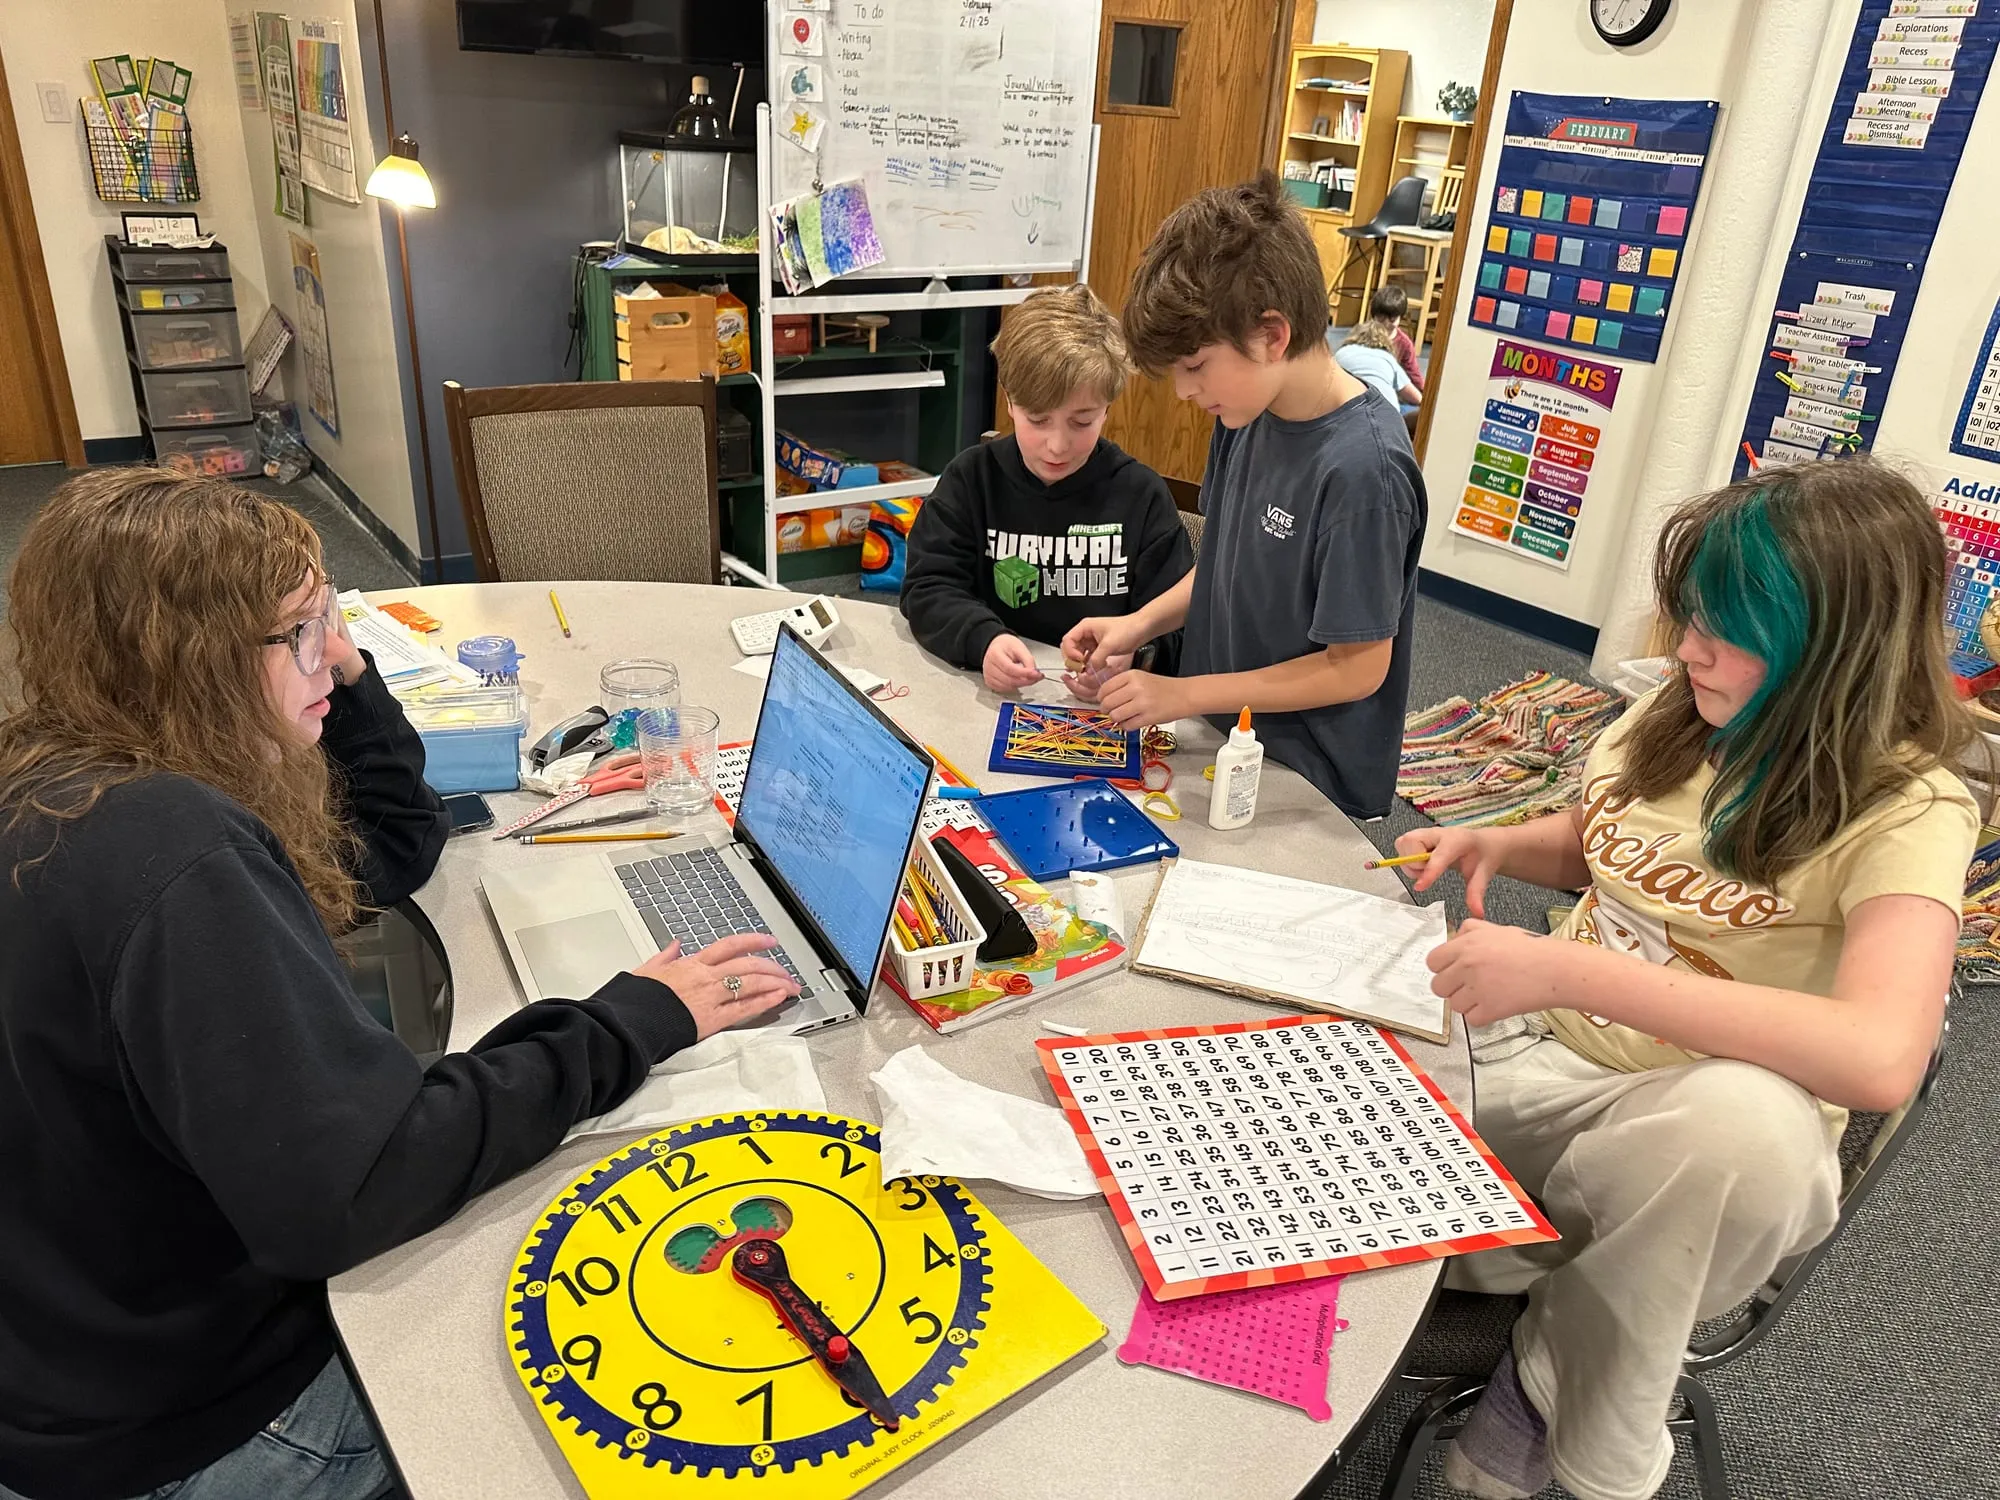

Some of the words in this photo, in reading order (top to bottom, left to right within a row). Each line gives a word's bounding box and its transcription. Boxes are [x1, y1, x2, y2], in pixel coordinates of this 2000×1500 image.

[854, 4, 866, 19] To
[872, 4, 884, 19] do
[1895, 23, 1948, 34] Explorations
[841, 32, 871, 51] Writing
[1899, 47, 1928, 56] Recess
[1885, 75, 1906, 85] Bible
[1908, 76, 1937, 86] Lesson
[1877, 98, 1916, 108] Afternoon
[1879, 107, 1910, 118] Meeting
[1570, 124, 1627, 141] FEBRUARY
[1867, 121, 1892, 131] Recess
[1894, 123, 1909, 131] and
[1868, 130, 1903, 140] Dismissal
[1844, 291, 1866, 301] Trash
[1805, 313, 1828, 326] Lizard
[1784, 326, 1813, 339] Teacher
[1807, 355, 1826, 366] Wipe
[1501, 347, 1606, 392] MONTHS
[1988, 368, 1997, 378] 71
[1803, 380, 1825, 392] Snack
[1982, 385, 1991, 395] 81
[1520, 390, 1538, 400] There
[1553, 398, 1561, 406] 12
[1563, 402, 1589, 413] months
[1798, 401, 1822, 413] Prayer
[1977, 402, 1986, 411] 91
[1497, 406, 1527, 421] January
[1970, 417, 1982, 427] 101
[1490, 427, 1522, 443] February
[1561, 423, 1578, 435] July
[1790, 422, 1805, 434] Flag
[1805, 425, 1828, 437] Salute
[1795, 432, 1819, 444] Leader
[1967, 433, 1976, 443] 111
[1983, 436, 1994, 446] 112
[1490, 450, 1513, 463] March
[1550, 445, 1578, 460] August
[1488, 473, 1505, 484] April
[1538, 465, 1579, 484] September
[1483, 495, 1499, 506] May
[1538, 489, 1568, 504] October
[1267, 503, 1295, 528] VANS
[1961, 504, 1968, 512] 3
[1981, 509, 1988, 517] 4
[1475, 515, 1494, 527] June
[1528, 510, 1566, 528] November
[1977, 521, 1983, 529] 5
[1067, 523, 1123, 536] MINECRAFT
[1522, 531, 1560, 550] December
[985, 528, 1128, 567] SURVIVAL
[1042, 565, 1129, 597] MODE
[1977, 573, 1989, 581] 10
[1974, 584, 1984, 593] 11
[1583, 772, 1792, 927] Pochaco
[1351, 1020, 1375, 1038] 120
[1365, 1039, 1389, 1055] 119
[1061, 1052, 1080, 1065] 10
[1381, 1058, 1403, 1072] 118
[1072, 1075, 1087, 1084] 9
[1396, 1077, 1419, 1092] 117
[1082, 1095, 1099, 1103] 8
[1413, 1096, 1436, 1112] 116
[754, 1121, 763, 1130] 5
[1092, 1116, 1110, 1125] 7
[1428, 1117, 1453, 1133] 115
[847, 1131, 861, 1139] 10
[1104, 1137, 1121, 1146] 6
[653, 1143, 668, 1154] 60
[739, 1136, 774, 1165] 1
[1446, 1138, 1471, 1155] 114
[820, 1142, 866, 1178] 2
[1115, 1160, 1134, 1169] 5
[646, 1151, 710, 1193] 12
[1465, 1160, 1489, 1177] 113
[925, 1176, 938, 1186] 15
[884, 1176, 928, 1211] 3
[1128, 1183, 1145, 1195] 4
[1483, 1182, 1507, 1200] 112
[568, 1202, 583, 1214] 55
[591, 1193, 642, 1234] 11
[1141, 1208, 1159, 1219] 3
[1504, 1211, 1525, 1223] 111
[1154, 1233, 1173, 1245] 2
[922, 1232, 956, 1274] 4
[963, 1247, 979, 1258] 20
[551, 1256, 620, 1308] 10
[528, 1283, 544, 1295] 50
[899, 1296, 943, 1345] 5
[1314, 1303, 1329, 1349] Multiplication
[951, 1330, 967, 1343] 25
[561, 1334, 603, 1381] 9
[1312, 1349, 1323, 1366] Grid
[545, 1366, 561, 1379] 45
[631, 1382, 683, 1432] 8
[736, 1380, 774, 1441] 7
[630, 1432, 647, 1446] 40
[755, 1449, 772, 1461] 35
[849, 1457, 882, 1479] ORIGINAL
[883, 1444, 900, 1459] JUDY
[901, 1430, 925, 1446] CLOCK
